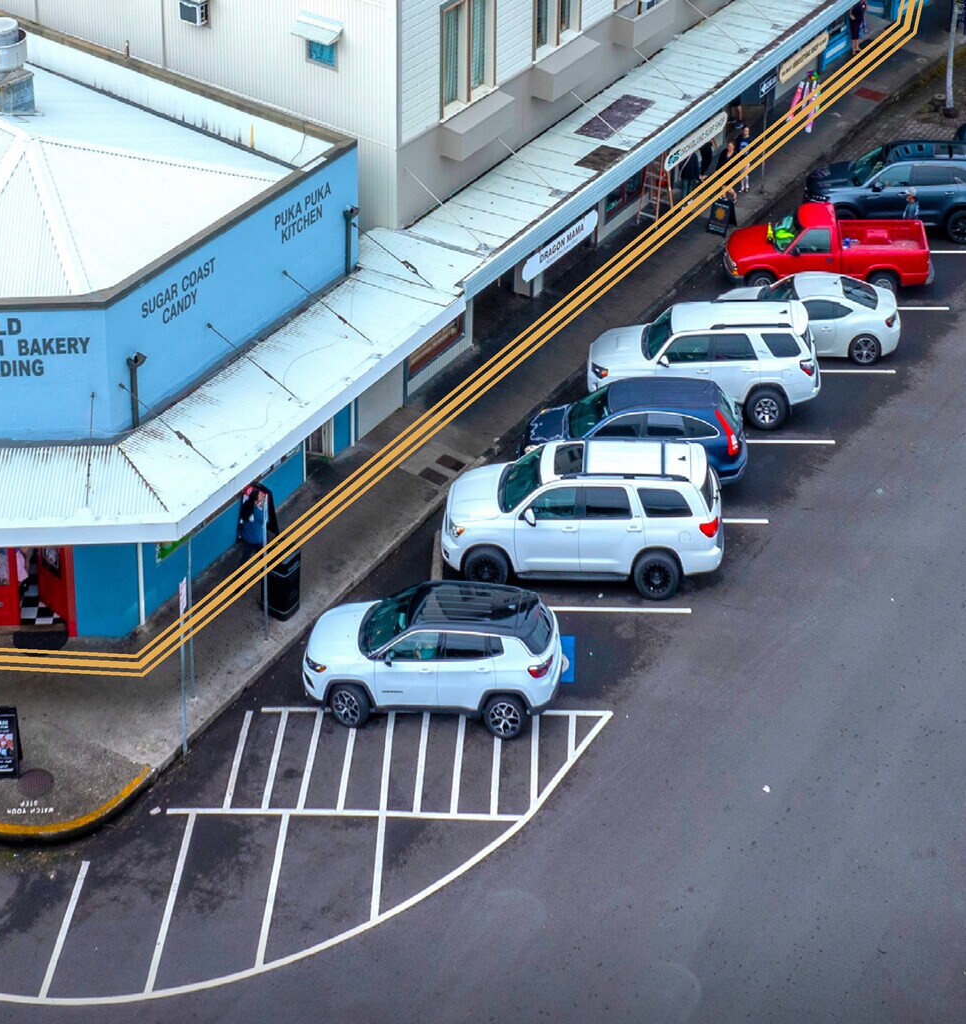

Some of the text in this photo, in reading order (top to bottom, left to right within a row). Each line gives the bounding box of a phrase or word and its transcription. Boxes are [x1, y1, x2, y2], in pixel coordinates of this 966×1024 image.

[275, 182, 332, 230] PUKA PUKA
[281, 204, 323, 244] KITCHEN
[539, 237, 566, 263] DRAGON
[566, 223, 584, 243] MAMA
[141, 257, 216, 319] SUGAR COAST
[162, 289, 198, 324] CANDY
[18, 337, 90, 356] BAKERY
[6, 807, 27, 815] YOUR
